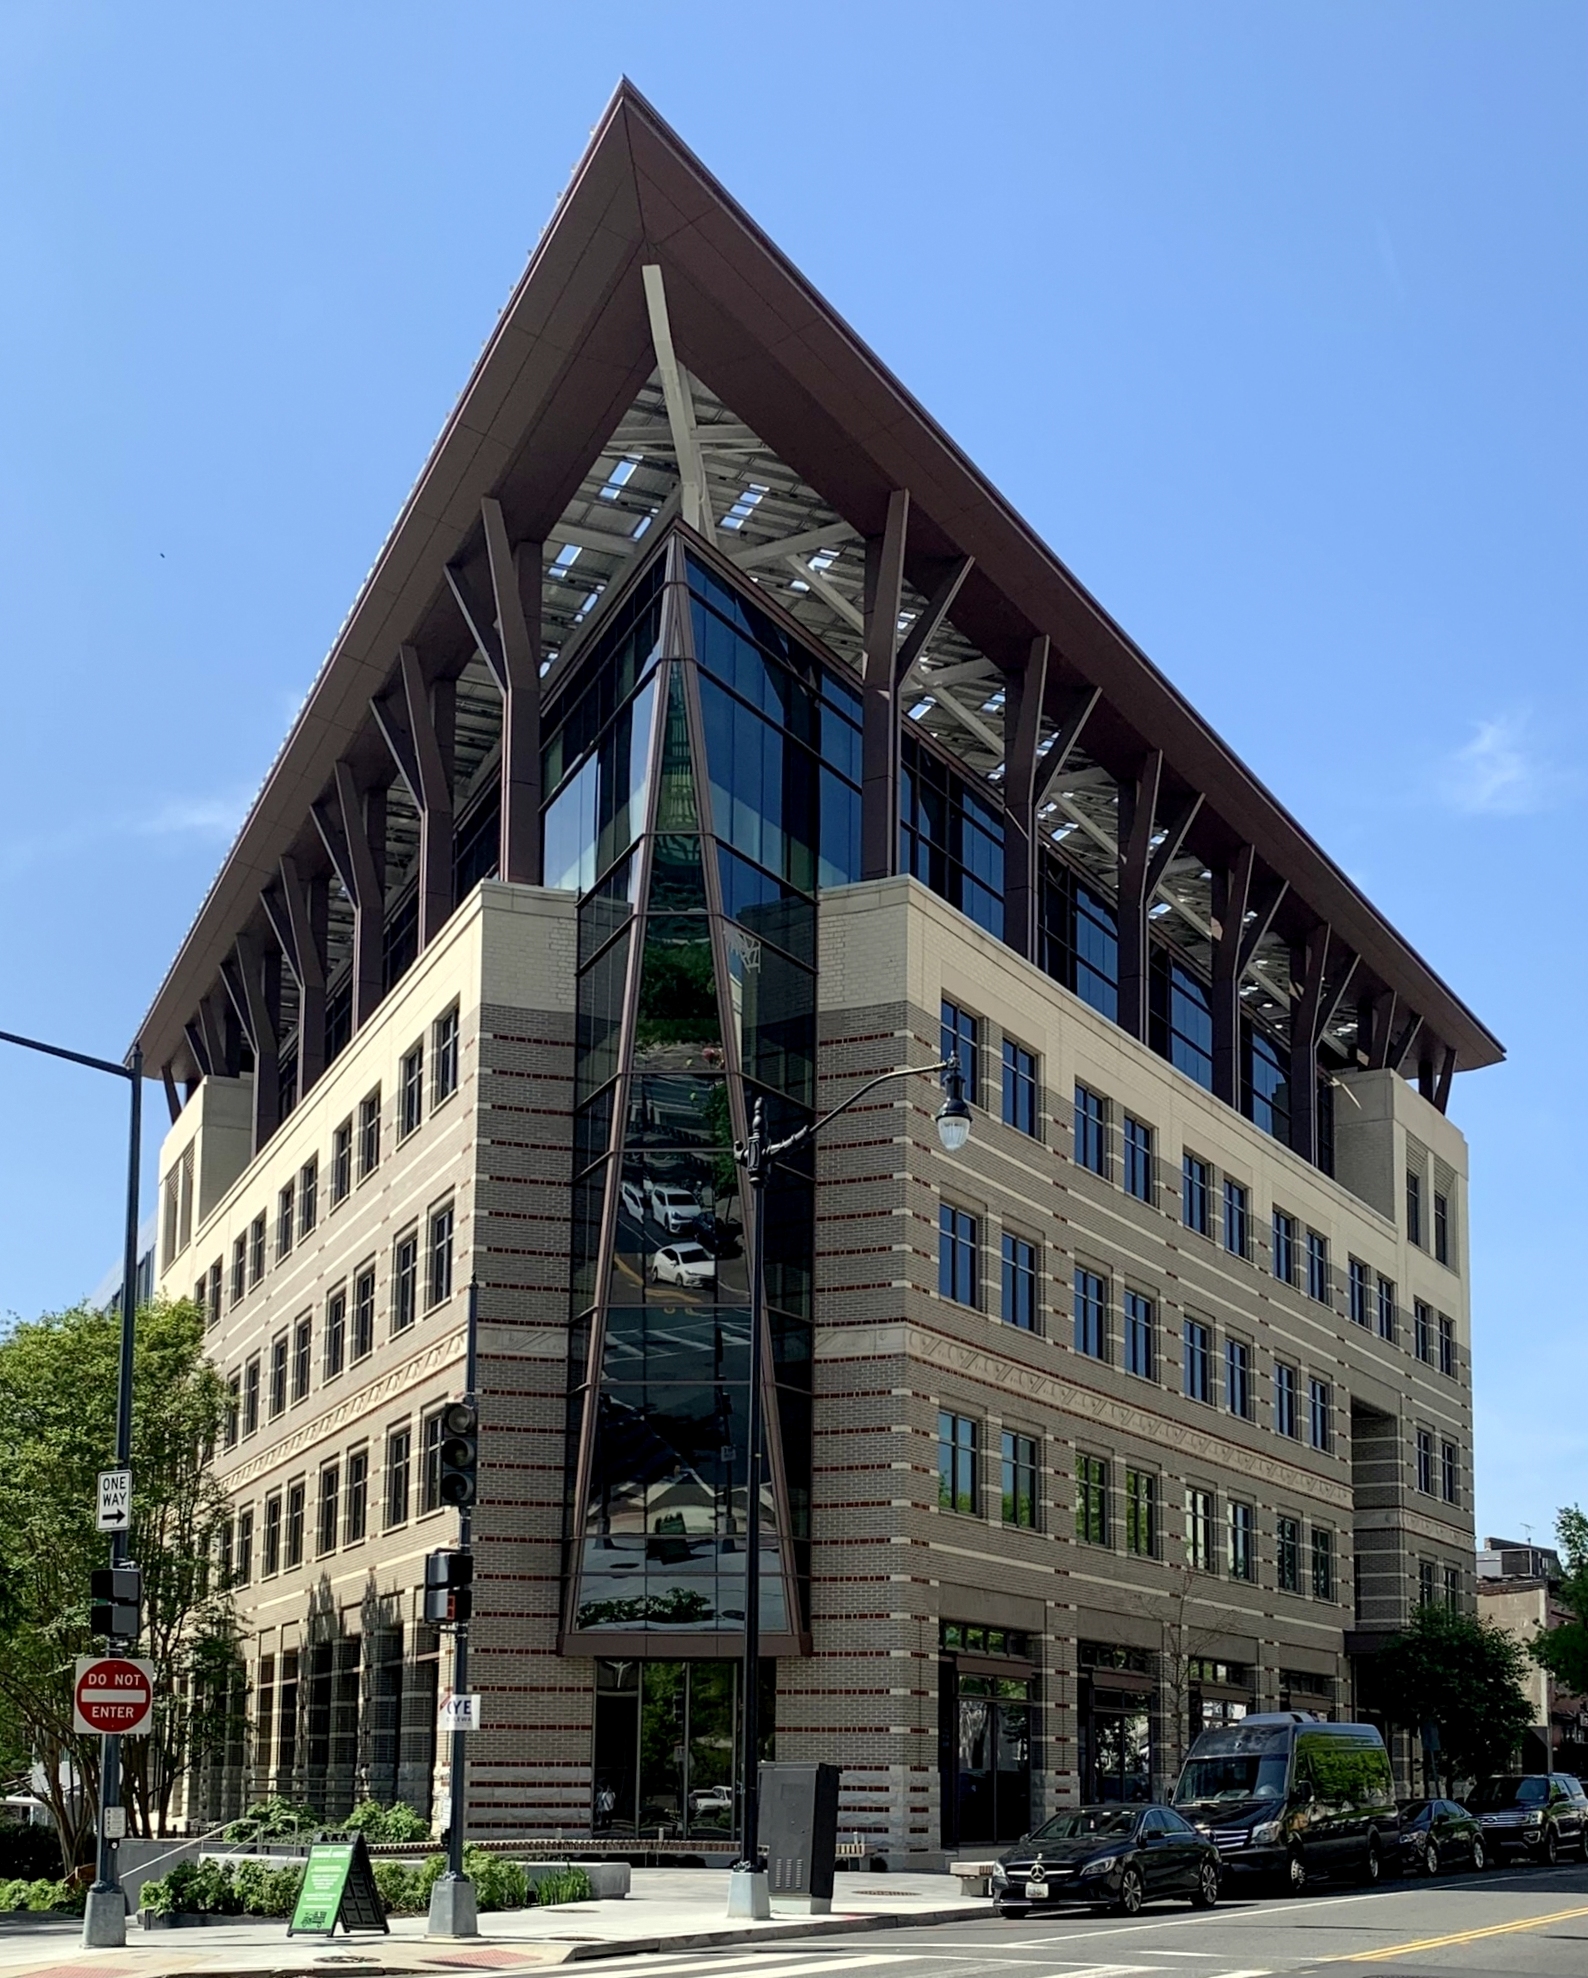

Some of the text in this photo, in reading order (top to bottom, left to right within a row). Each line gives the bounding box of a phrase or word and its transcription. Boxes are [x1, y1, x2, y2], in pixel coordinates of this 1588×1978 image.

[103, 1476, 126, 1491] ONE
[103, 1492, 127, 1507] WAY
[88, 1673, 141, 1686] DO NOT
[92, 1706, 134, 1719] ENTER
